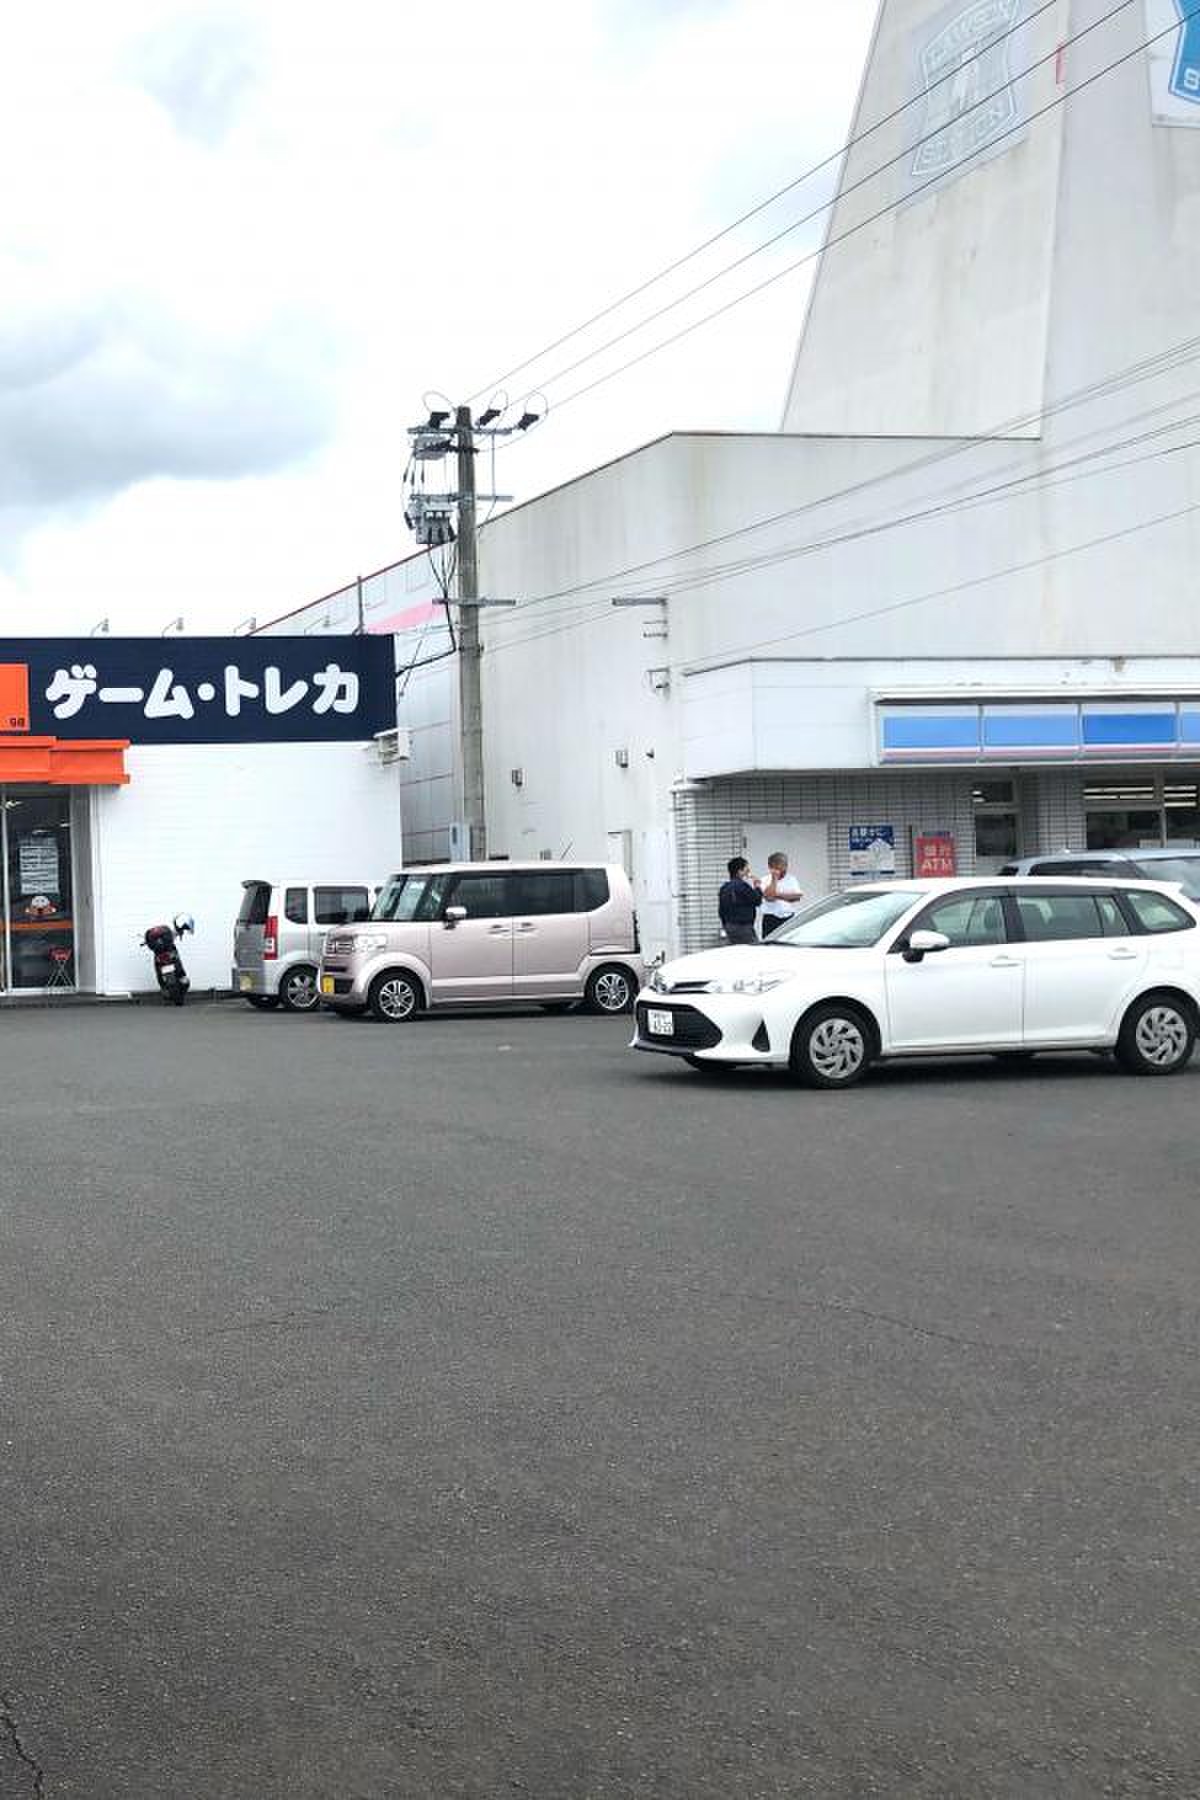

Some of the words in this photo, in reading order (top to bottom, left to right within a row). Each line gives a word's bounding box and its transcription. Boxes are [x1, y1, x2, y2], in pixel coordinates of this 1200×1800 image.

[45, 664, 359, 719] ゲーム・トレカ
